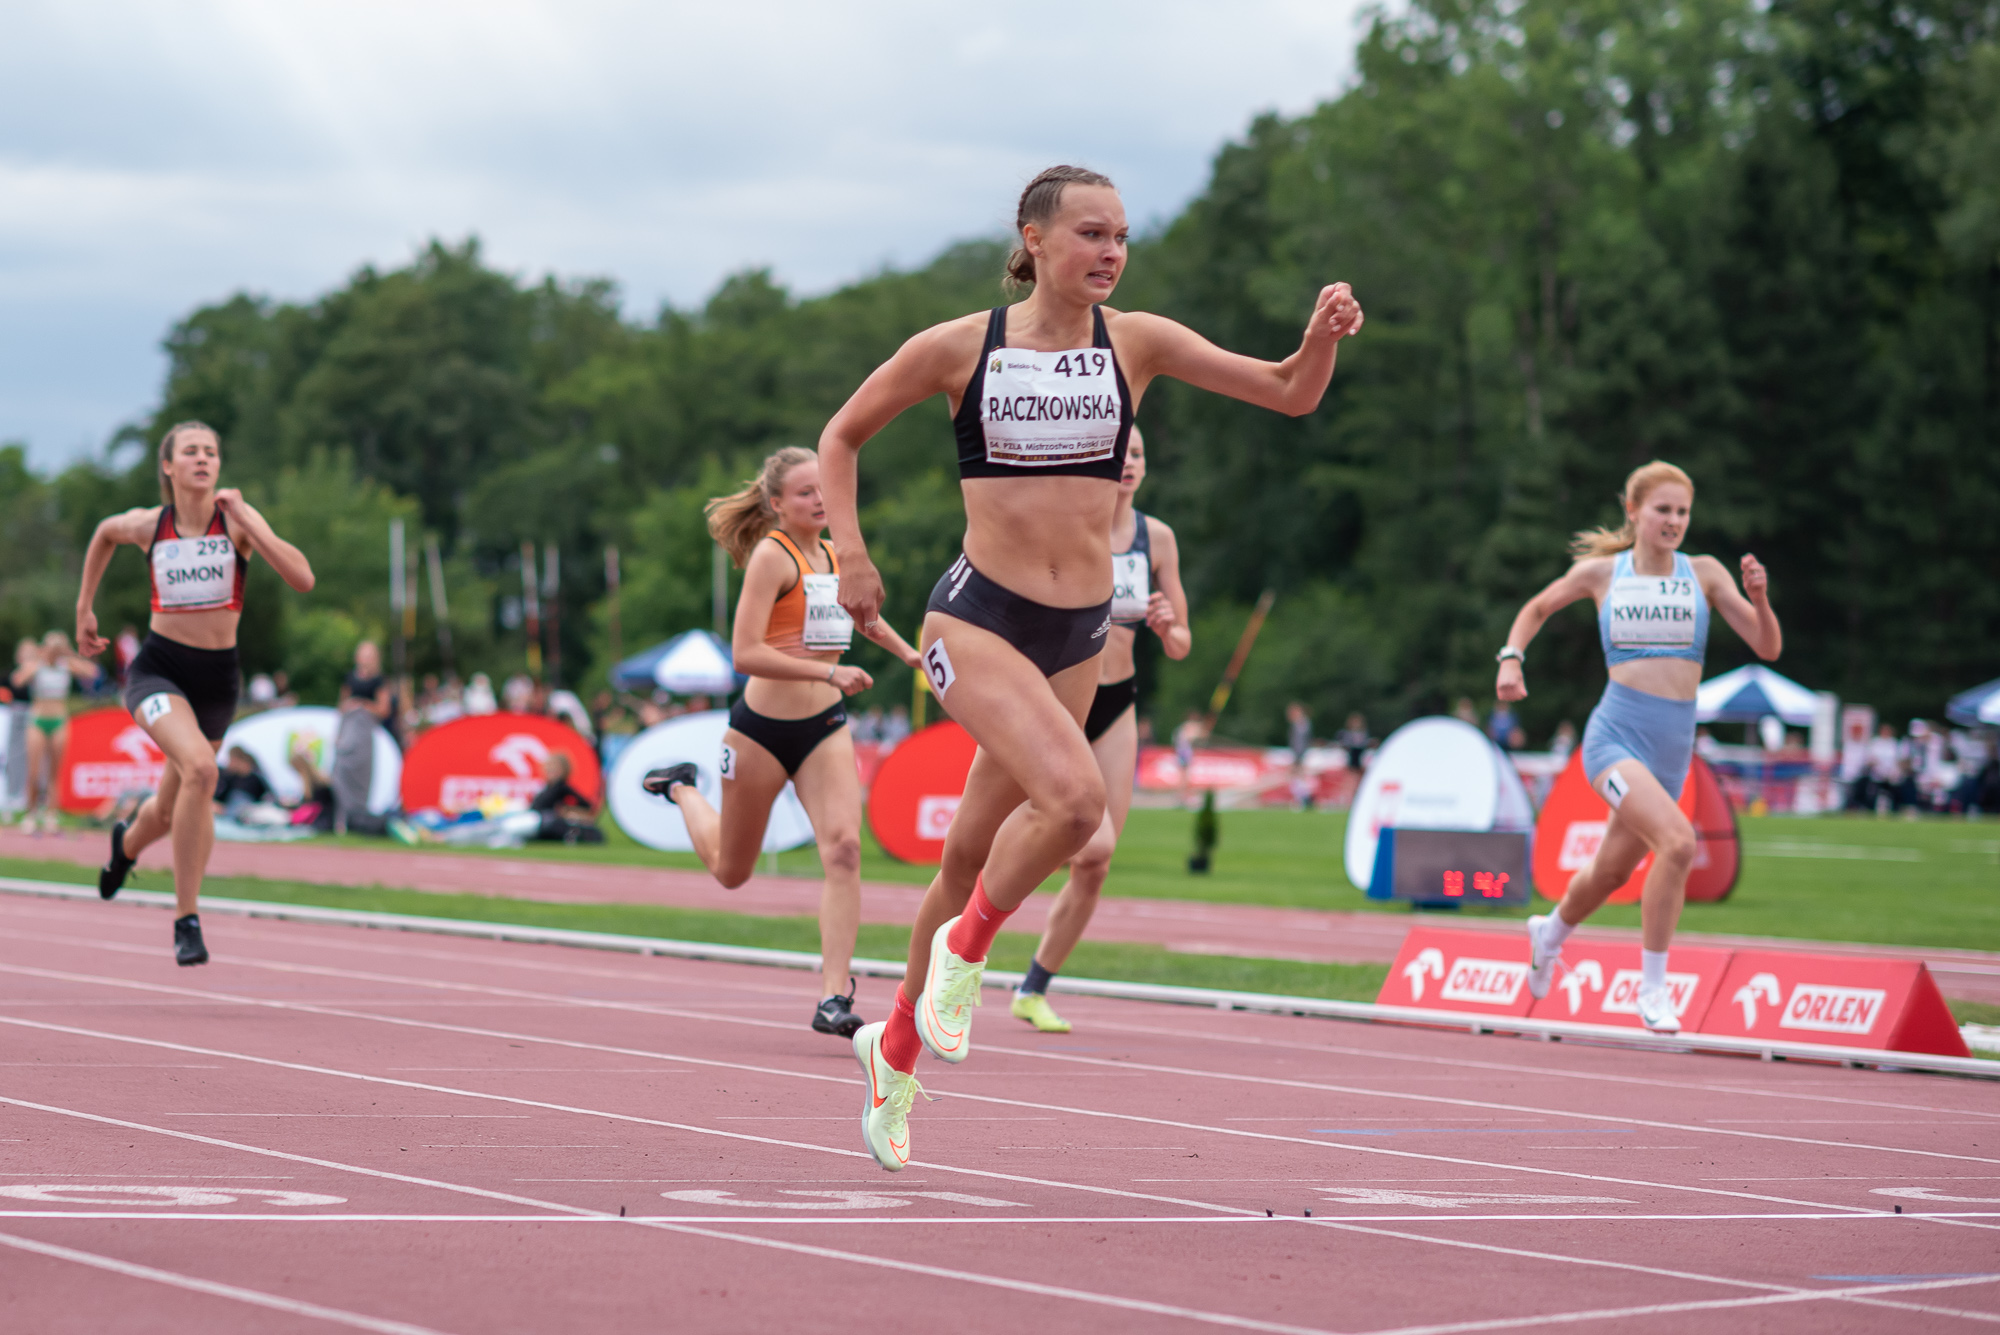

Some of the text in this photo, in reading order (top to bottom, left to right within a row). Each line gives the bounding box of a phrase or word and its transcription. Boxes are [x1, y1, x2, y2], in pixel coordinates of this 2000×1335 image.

[1054, 352, 1106, 378] 419
[989, 394, 1116, 421] RACZKOWSKA
[1025, 440, 1075, 451] Mistrzostwa
[197, 539, 229, 556] 293
[166, 565, 223, 585] SIMON
[1659, 580, 1691, 596] 175
[1613, 605, 1693, 621] KWIATEK
[927, 646, 947, 690] 5
[149, 698, 164, 717] 4
[720, 748, 730, 775] 3
[1608, 778, 1621, 797] 1
[1451, 966, 1520, 996] ORLEN
[1612, 978, 1689, 1009] ORN
[1791, 993, 1876, 1025] ORLEN
